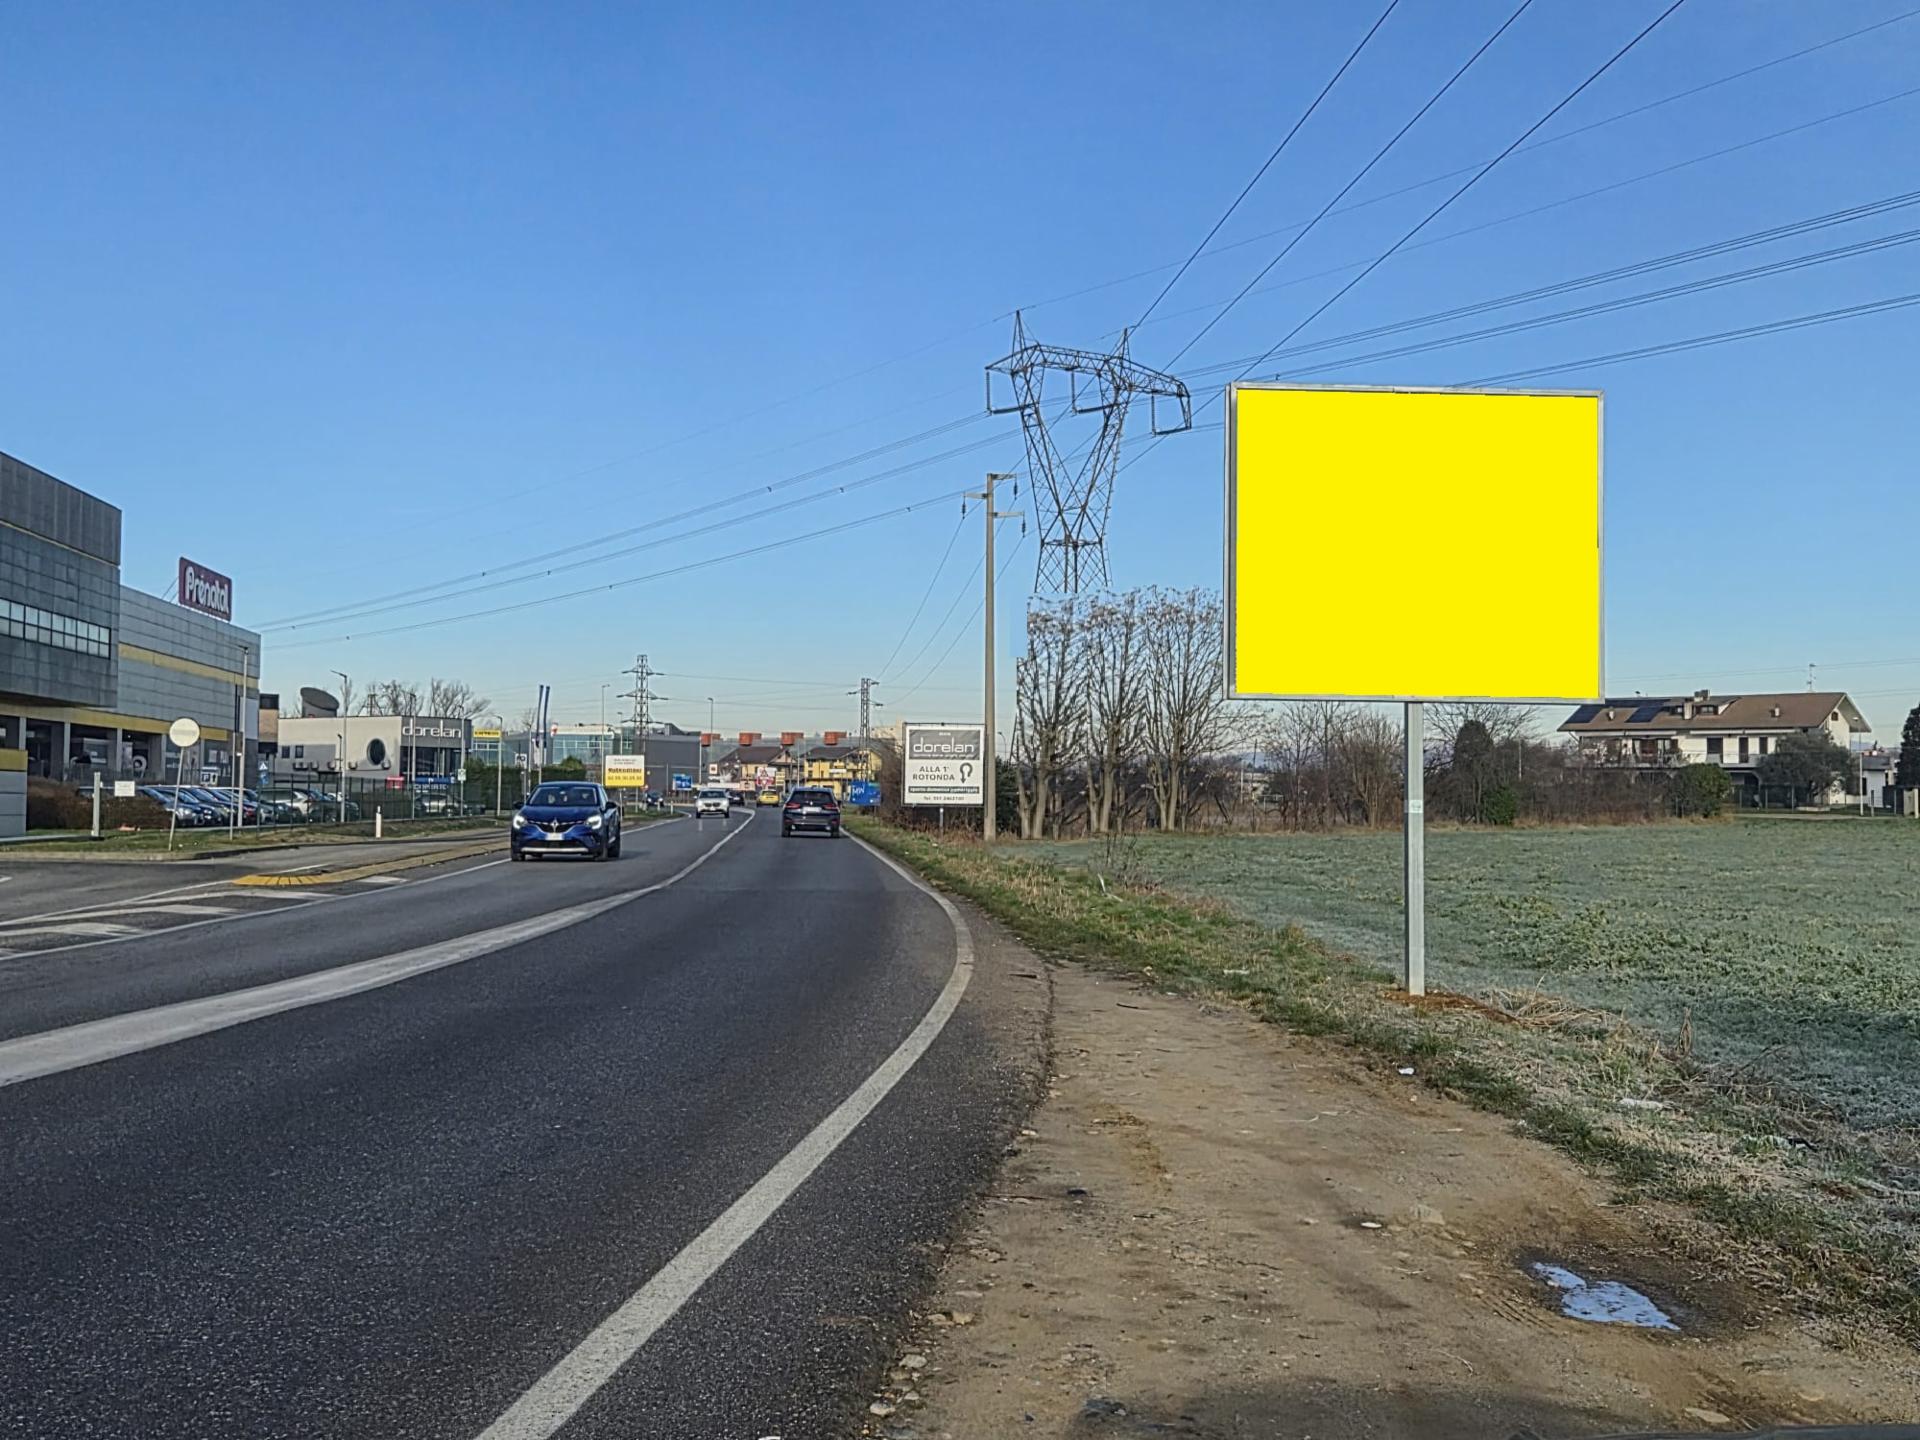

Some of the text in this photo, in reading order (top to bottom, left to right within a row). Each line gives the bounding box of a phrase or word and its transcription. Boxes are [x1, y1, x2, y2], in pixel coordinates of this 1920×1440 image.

[402, 718, 462, 739] dorelan
[913, 737, 974, 753] dorelan
[912, 773, 955, 781] ROTONDA
